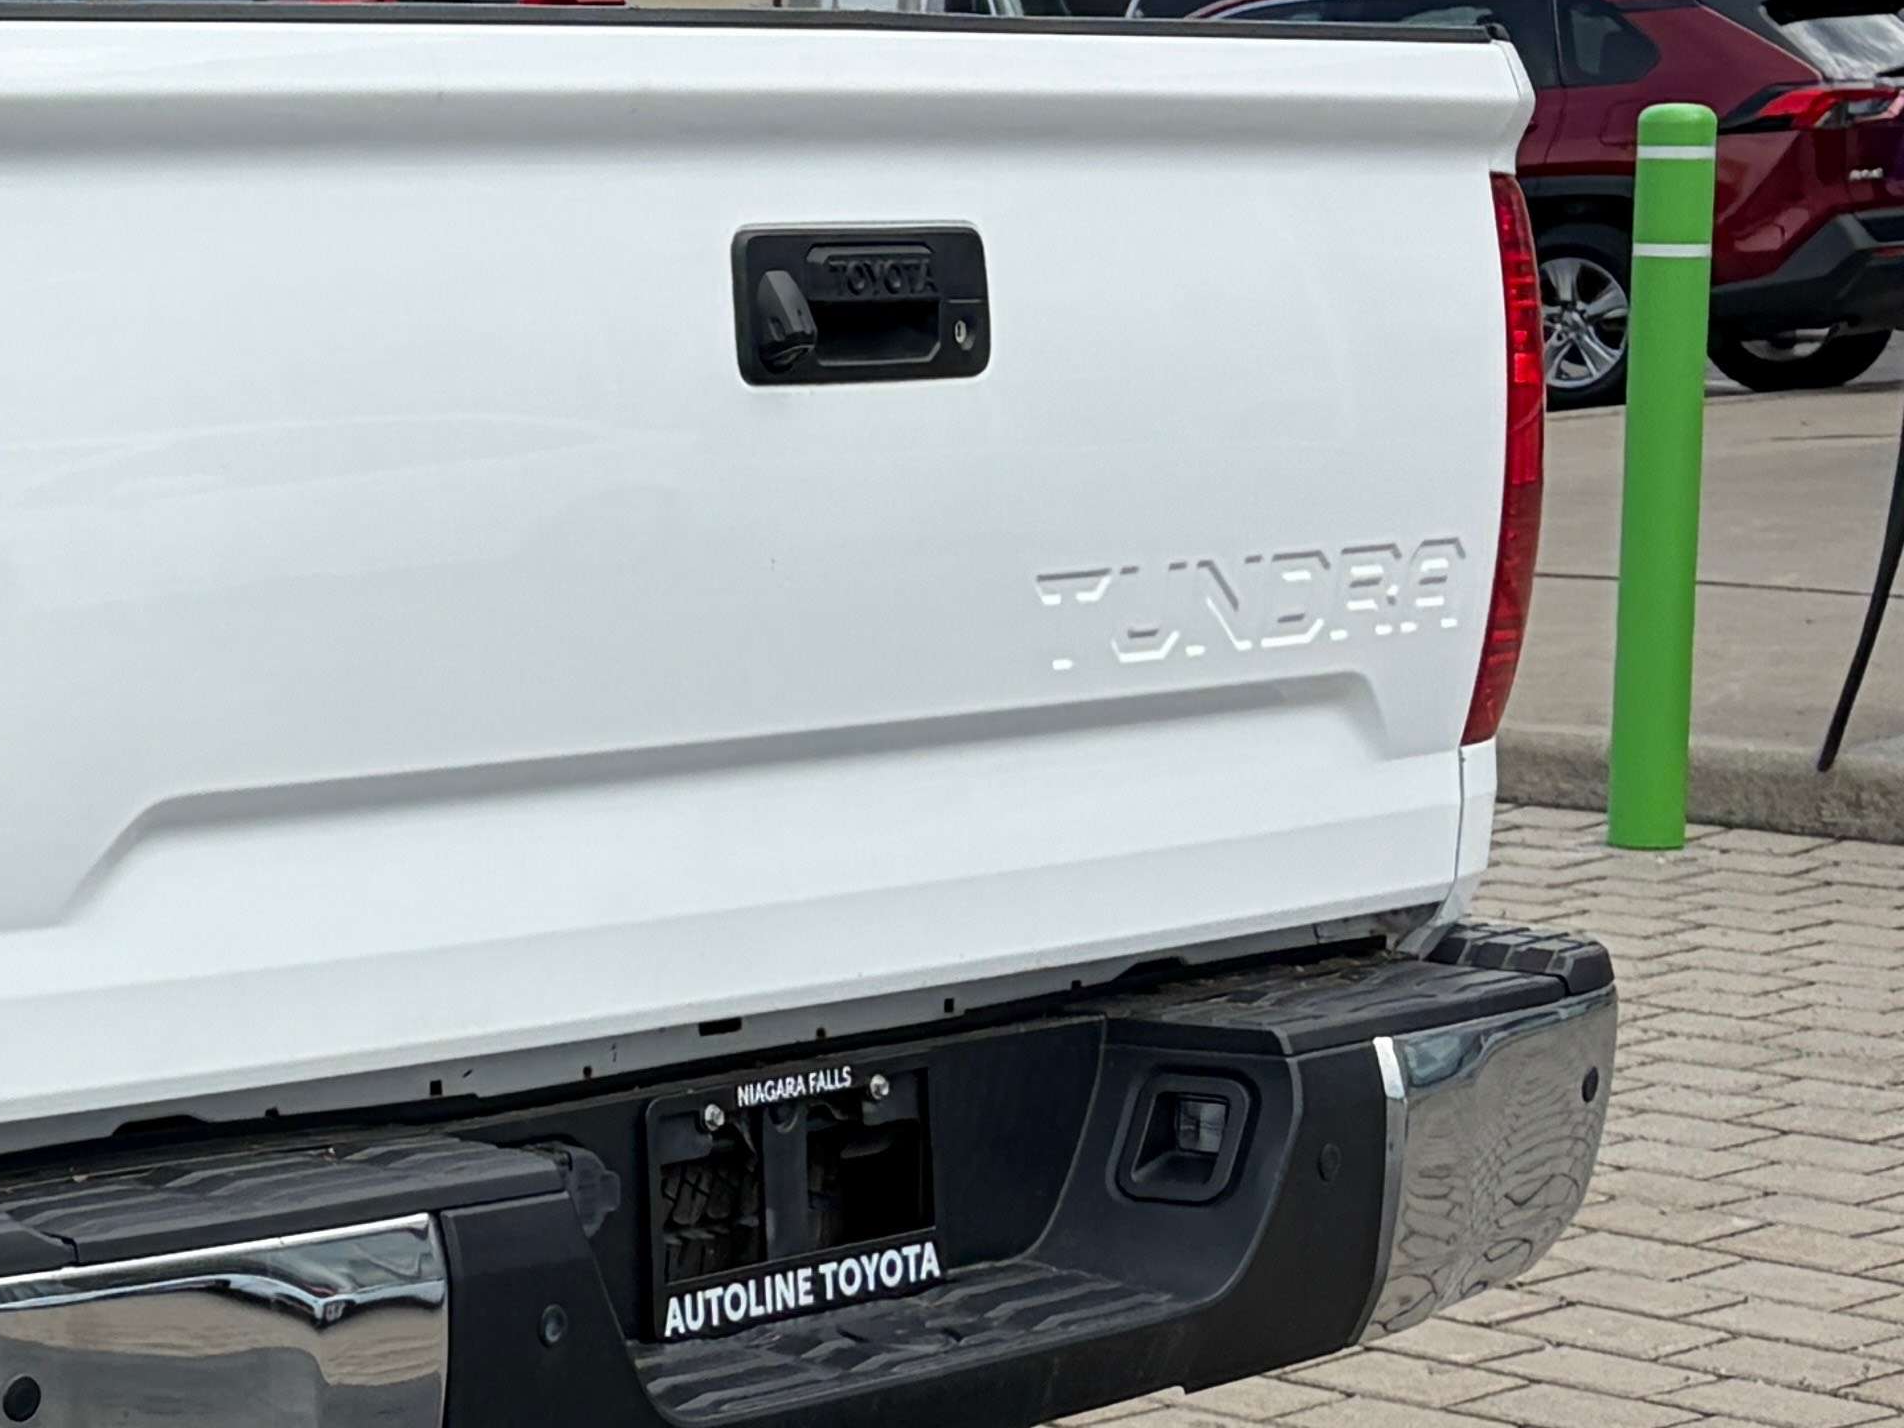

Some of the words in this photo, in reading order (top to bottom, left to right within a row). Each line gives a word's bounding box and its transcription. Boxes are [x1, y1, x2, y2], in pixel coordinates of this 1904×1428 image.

[1035, 536, 1467, 671] TUNDRA
[737, 1075, 807, 1107] NIAGARA
[808, 1066, 852, 1093] FALLS
[664, 1268, 814, 1338] AUTOLINE
[818, 1241, 941, 1301] TOYOTA
